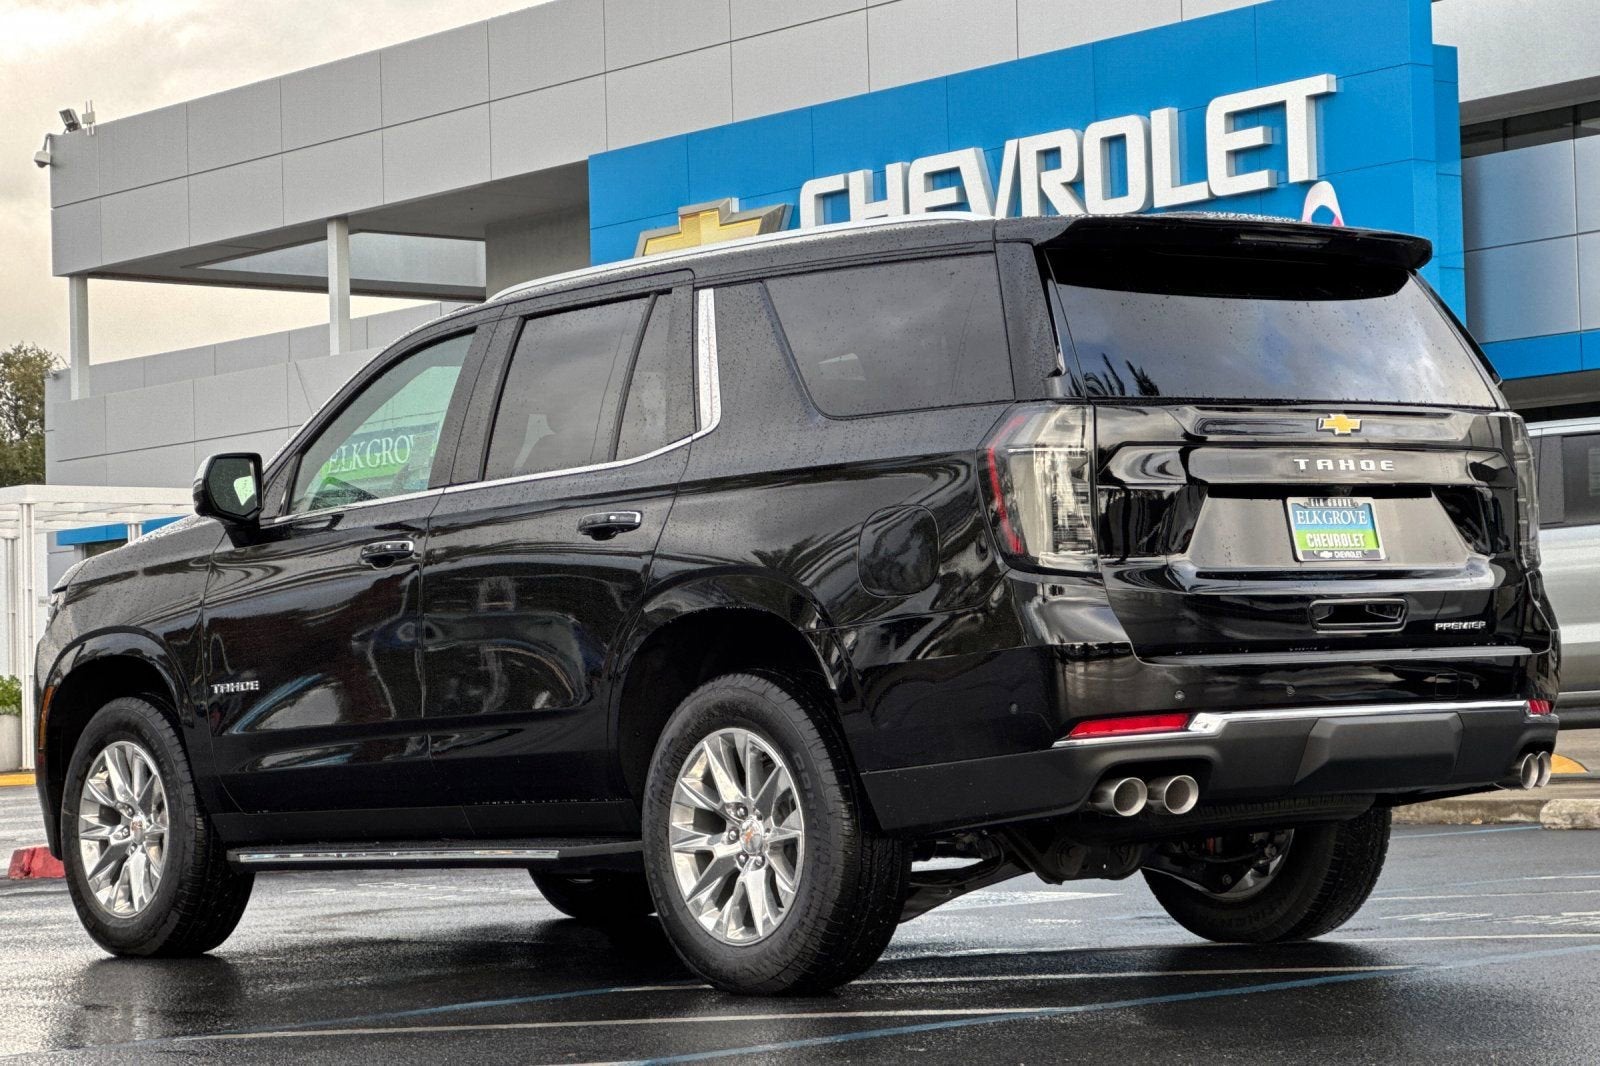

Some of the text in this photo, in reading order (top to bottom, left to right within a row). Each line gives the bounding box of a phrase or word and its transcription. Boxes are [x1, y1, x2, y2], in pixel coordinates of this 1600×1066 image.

[801, 73, 1337, 229] CHEVROLET
[366, 434, 416, 468] GRO
[1294, 458, 1395, 471] TAHOE
[1322, 510, 1367, 525] GROVE
[1306, 533, 1366, 548] CHEVROLET
[1334, 550, 1362, 558] CHEVROLET
[1435, 620, 1486, 630] PREMIER
[210, 680, 259, 693] TAHOE
